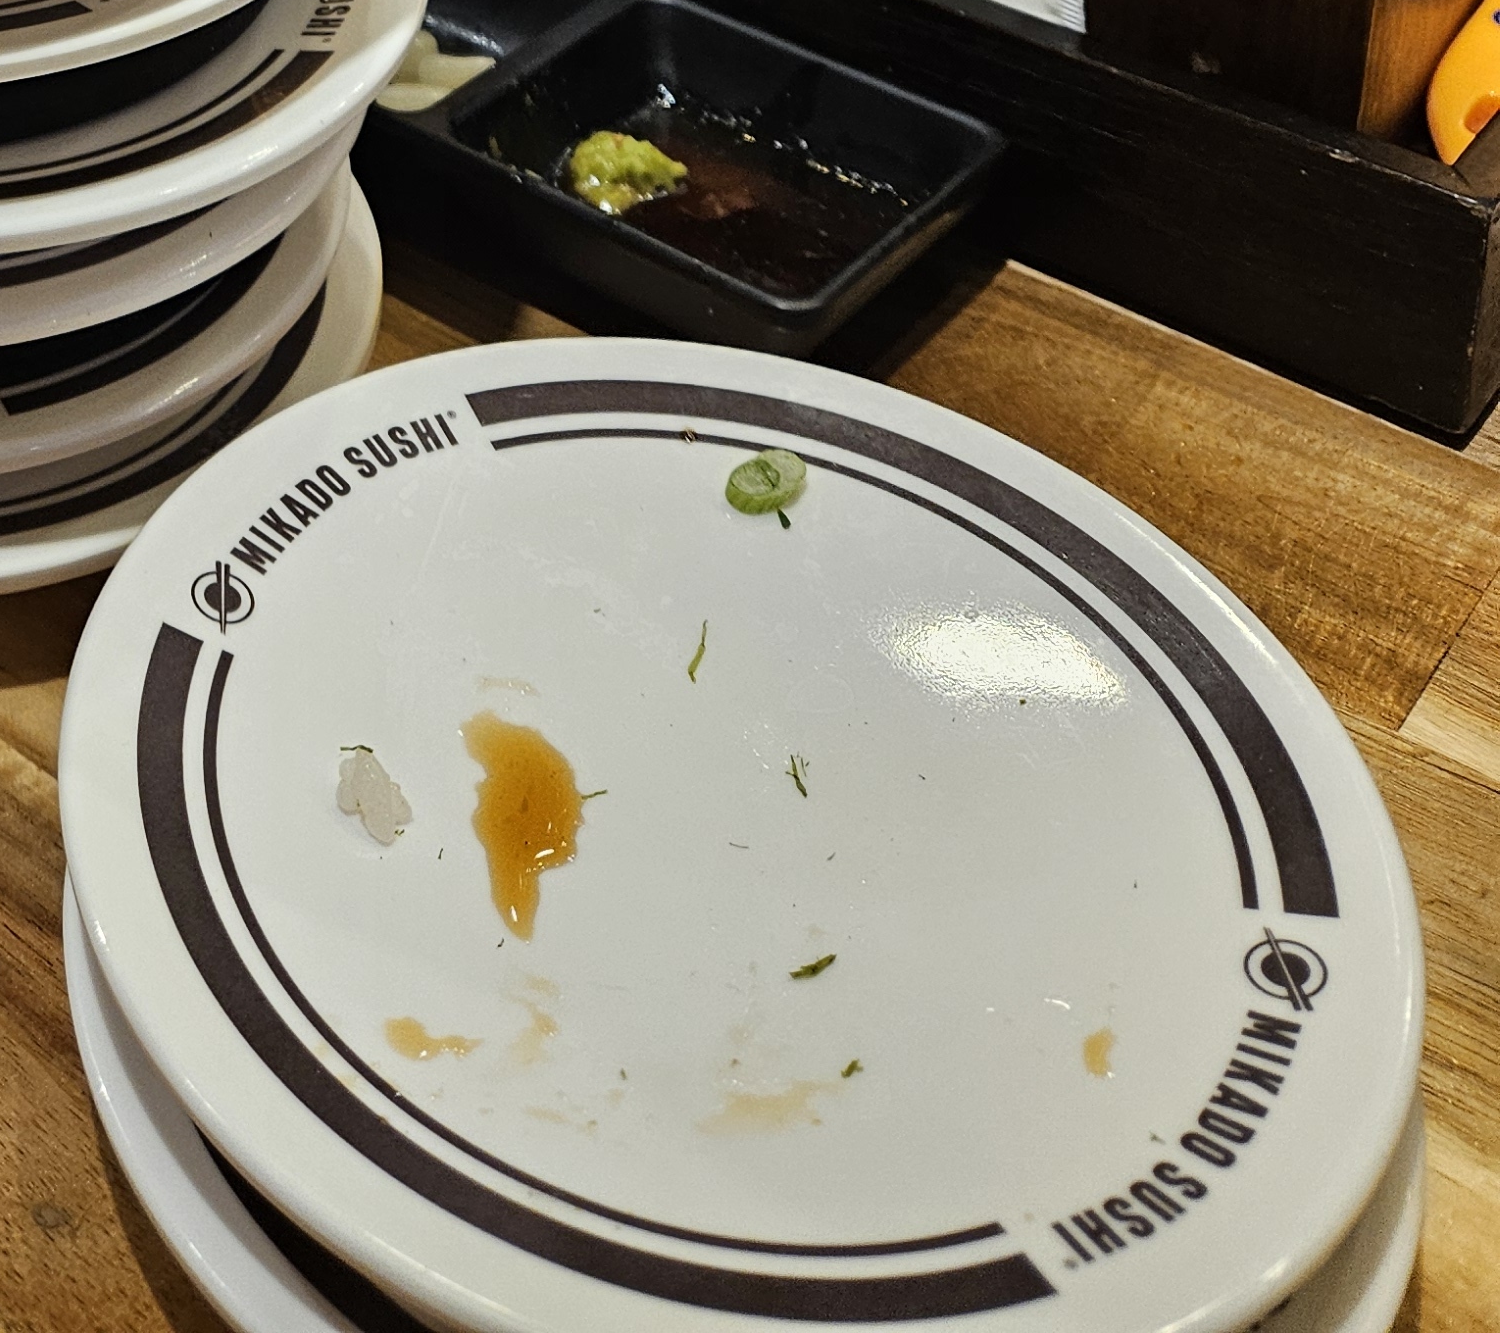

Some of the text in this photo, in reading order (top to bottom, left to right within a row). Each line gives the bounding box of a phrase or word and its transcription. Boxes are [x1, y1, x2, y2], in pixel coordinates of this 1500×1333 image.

[230, 413, 458, 575] MIKADO SUSHI
[1051, 1010, 1302, 1263] MIKADO SUSHI
